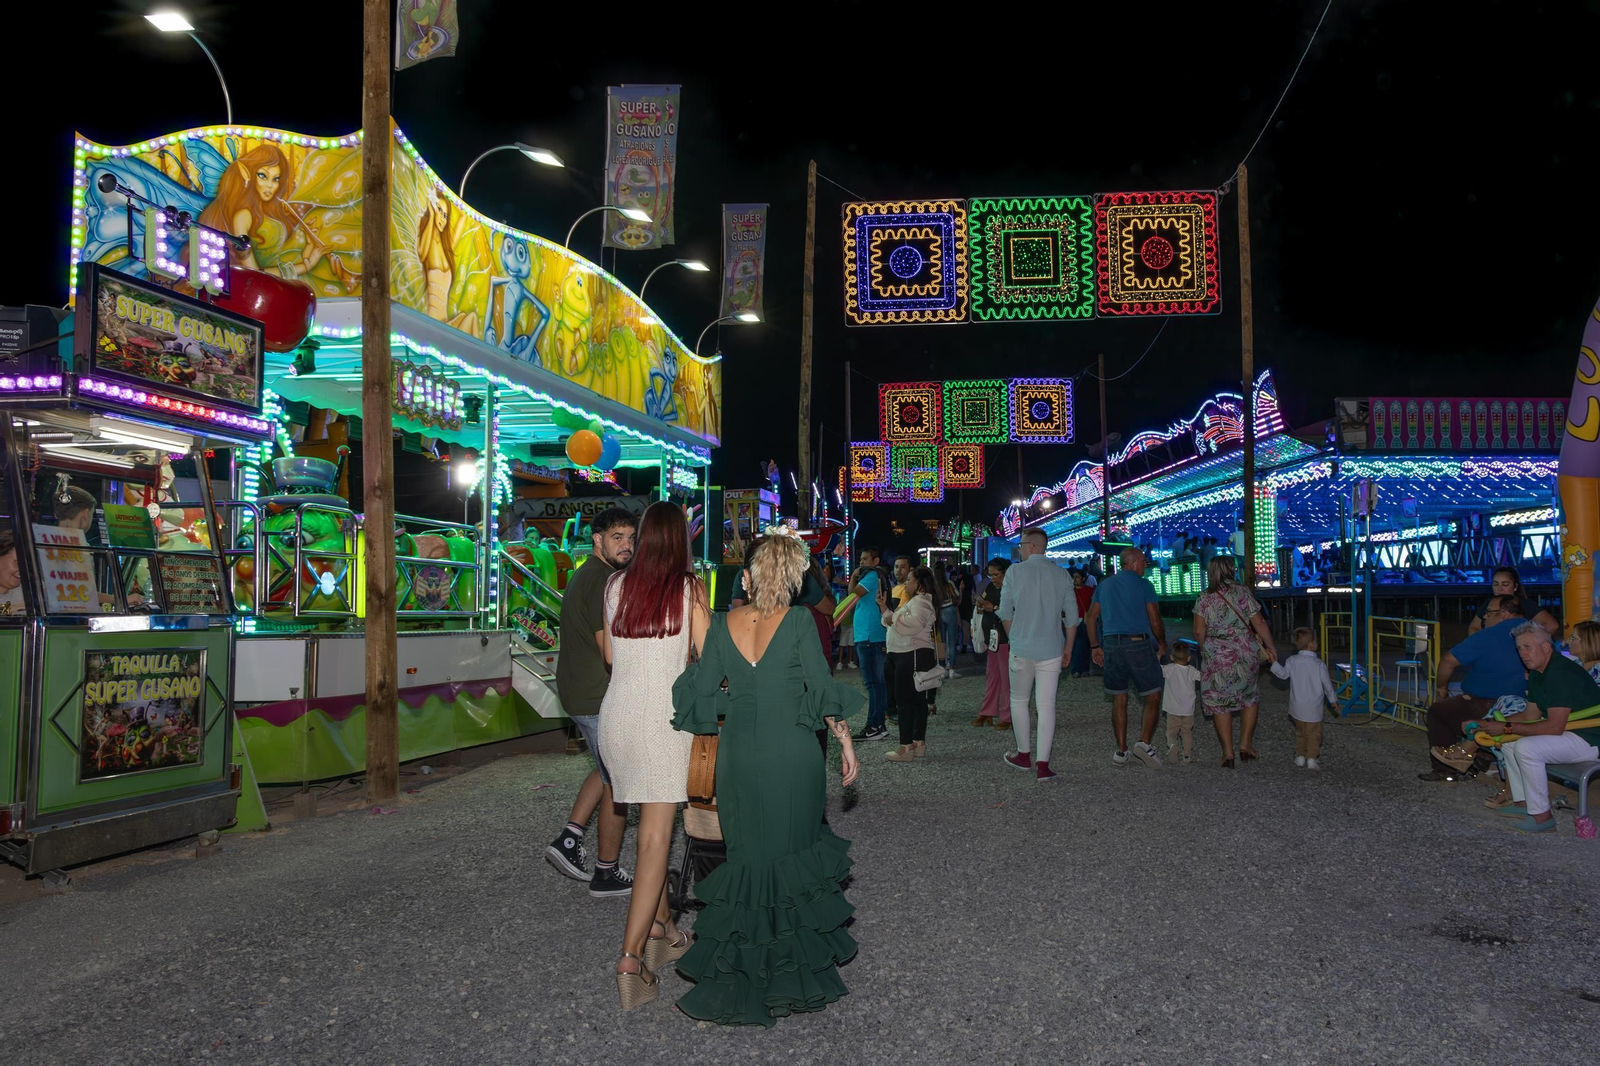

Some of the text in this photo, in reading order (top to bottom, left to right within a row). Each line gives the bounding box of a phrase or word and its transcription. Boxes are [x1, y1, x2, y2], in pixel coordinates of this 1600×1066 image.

[620, 101, 657, 114] SUPER
[616, 123, 662, 138] GUSANO
[732, 213, 761, 223] SUPER
[116, 295, 247, 355] SUPER GUSANO
[41, 533, 80, 546] 1 VIAJE
[184, 558, 212, 569] MENORES
[50, 570, 89, 581] 4 VIAJES
[55, 583, 90, 602] 12€
[110, 654, 180, 675] TAQUILLA
[84, 676, 201, 706] SUPER GUSANO
